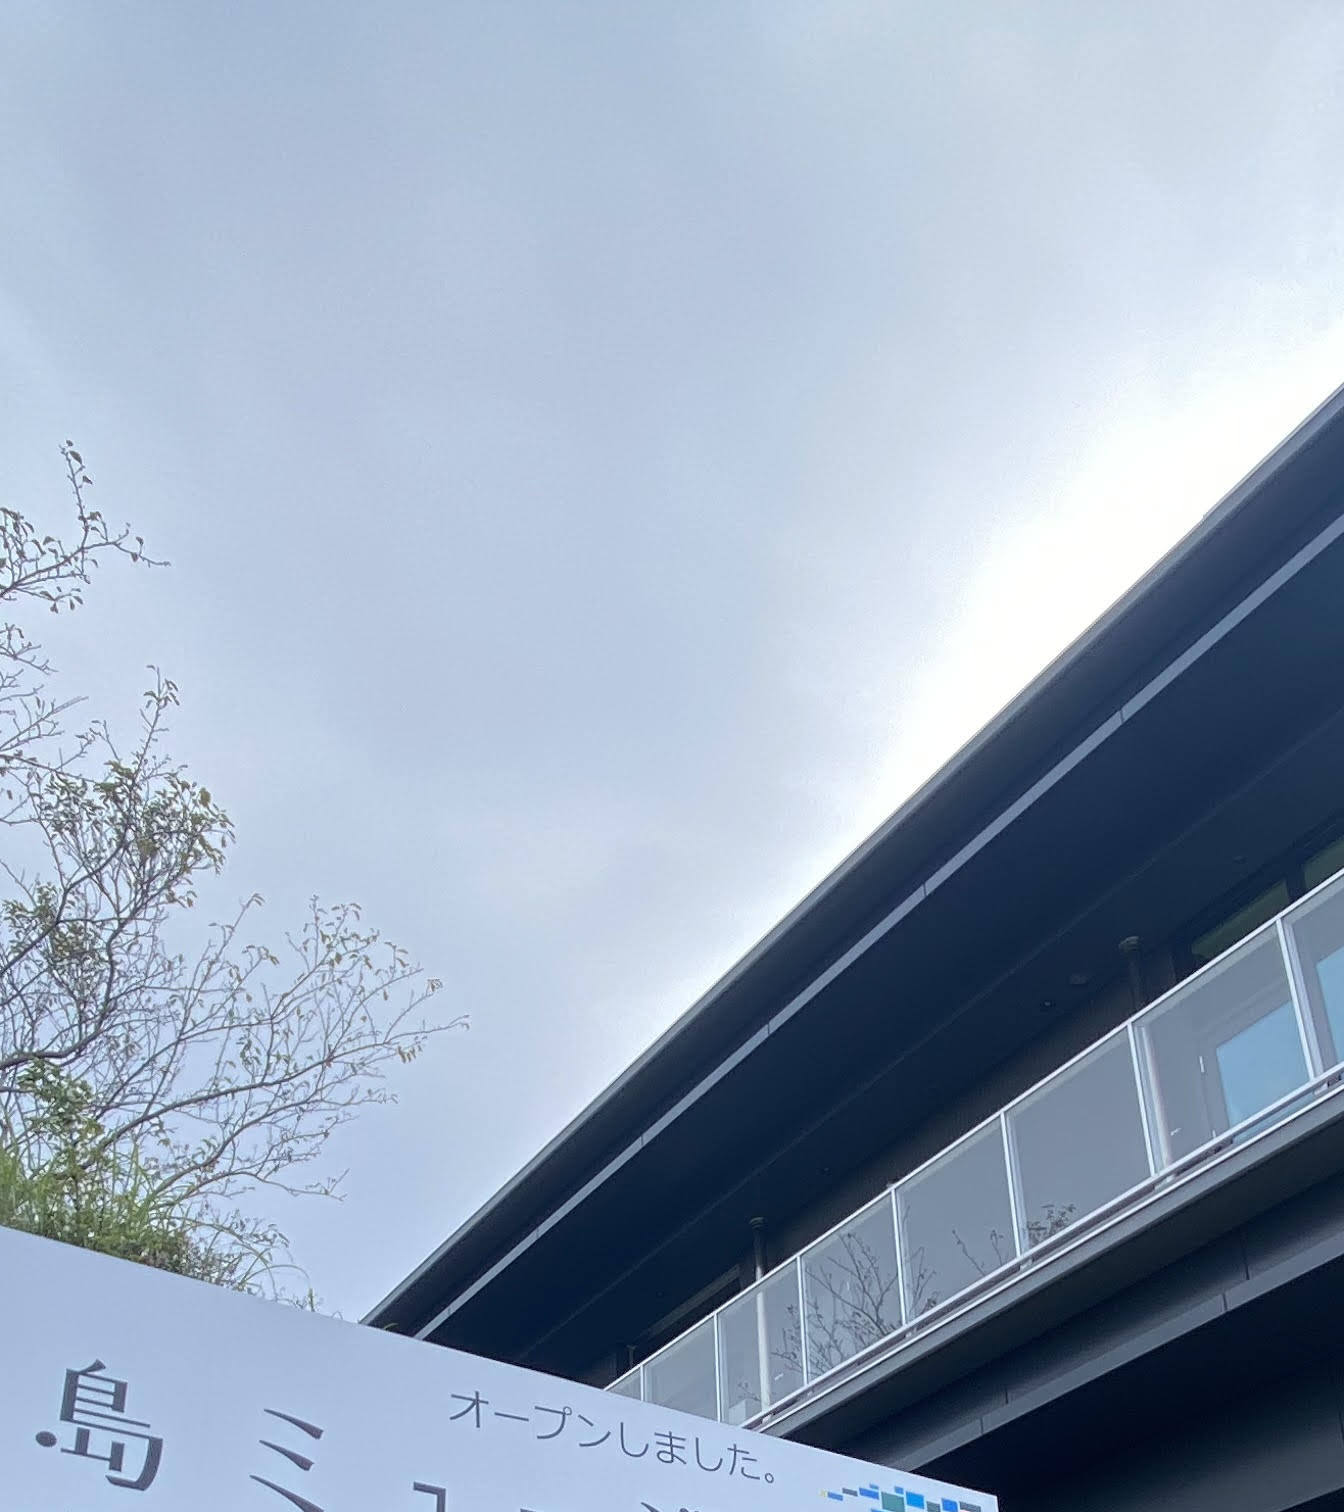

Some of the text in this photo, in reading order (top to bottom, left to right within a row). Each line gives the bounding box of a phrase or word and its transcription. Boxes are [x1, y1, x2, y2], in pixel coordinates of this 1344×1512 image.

[449, 1390, 775, 1484] オープンしました。
